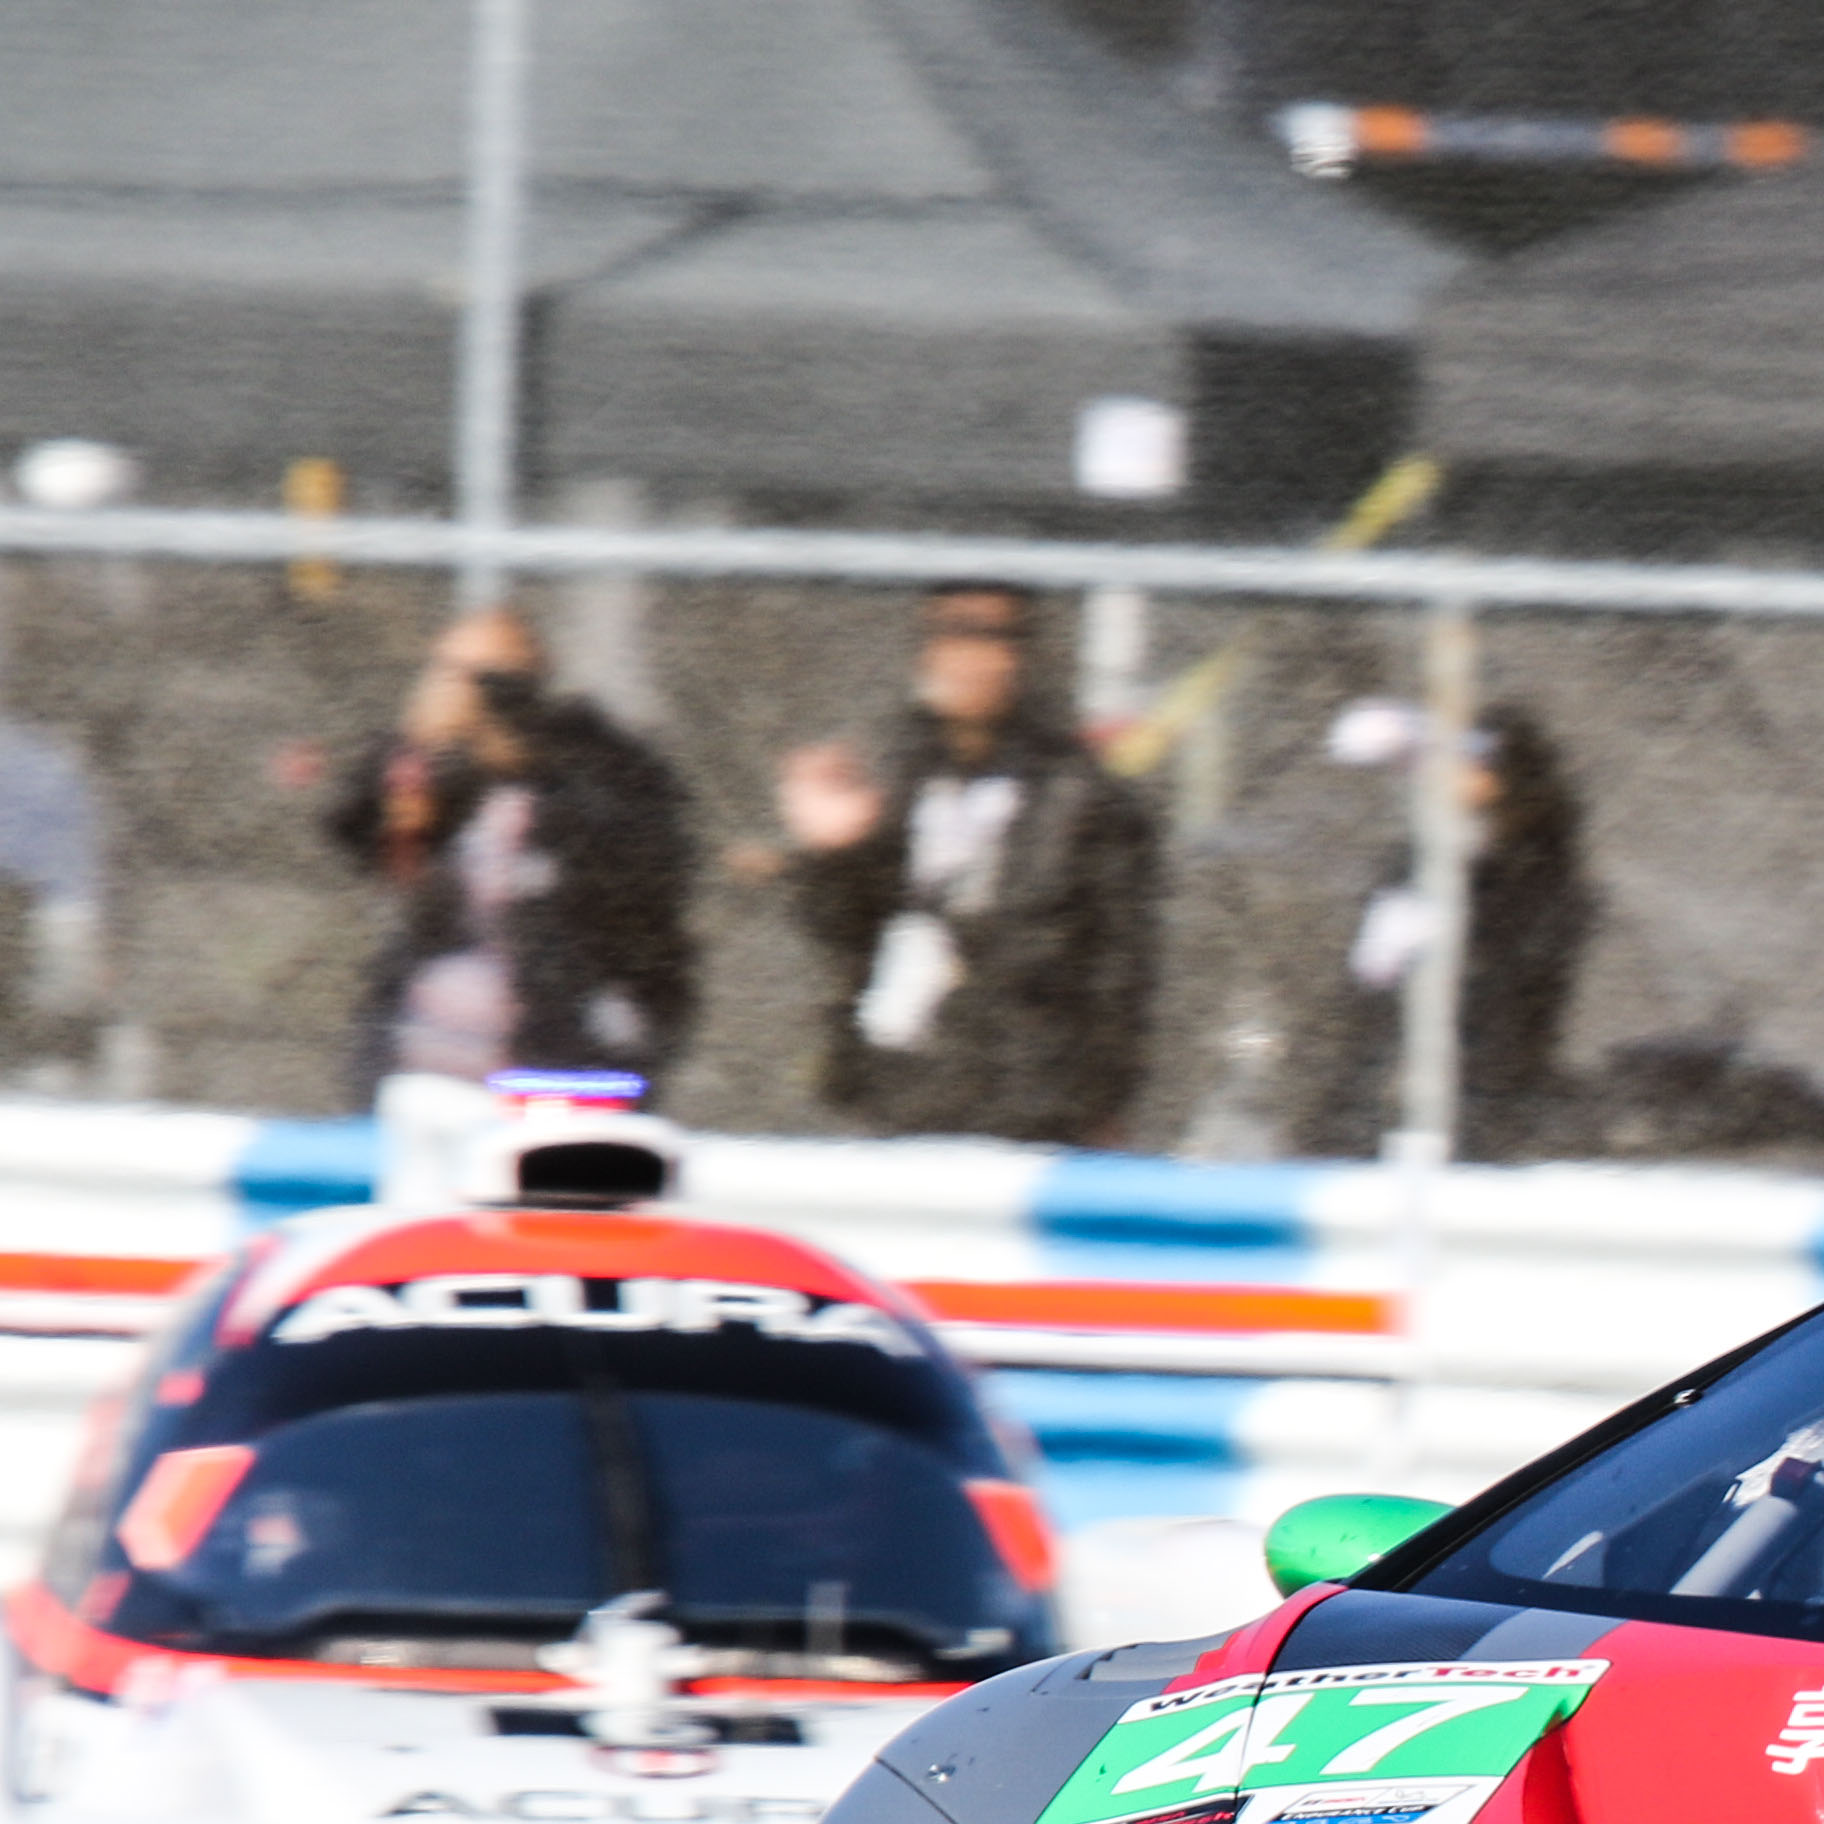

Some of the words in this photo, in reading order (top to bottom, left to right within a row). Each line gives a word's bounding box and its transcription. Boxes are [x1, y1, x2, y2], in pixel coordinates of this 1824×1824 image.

[273, 1273, 927, 1358] ACURA
[1149, 1664, 1583, 1713] WeatherTech
[1111, 1685, 1529, 1796] 47
[378, 1789, 829, 1824] ACUR
